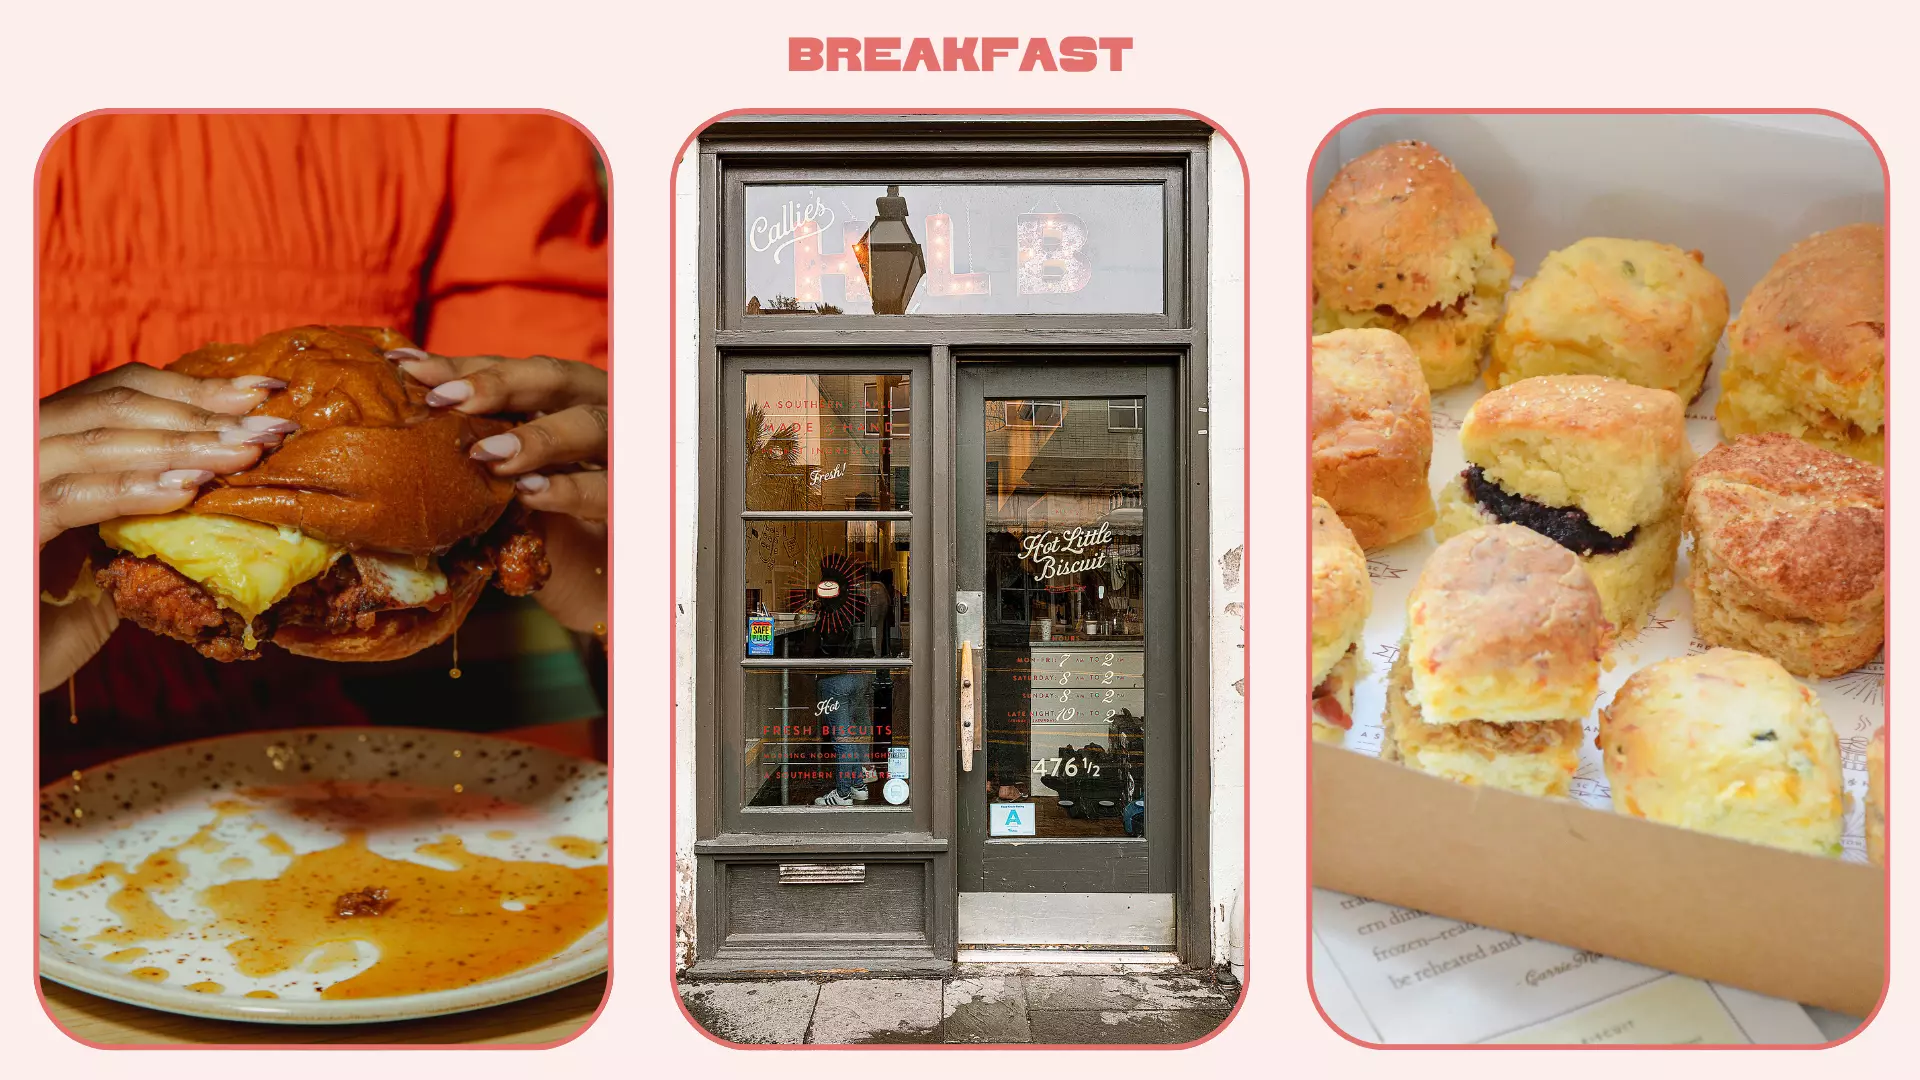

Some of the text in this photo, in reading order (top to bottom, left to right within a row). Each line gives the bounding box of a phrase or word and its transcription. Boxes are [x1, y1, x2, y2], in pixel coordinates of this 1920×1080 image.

[749, 188, 835, 265] Callie's
[777, 400, 843, 409] SOUTHERN
[763, 422, 813, 433] MADE
[809, 462, 847, 486] Fresh!
[1017, 521, 1113, 564] Hot Little
[1034, 551, 1106, 582] Biscuit
[753, 625, 770, 635] SAFE
[753, 634, 770, 642] PLACE
[1059, 653, 1071, 668] 7
[1101, 652, 1115, 667] 2
[1059, 671, 1071, 686] 8
[1101, 670, 1114, 685] 2
[1059, 688, 1071, 703] 8
[1101, 689, 1115, 704] 2
[814, 696, 841, 717] Hot
[1056, 706, 1076, 722] 10
[1102, 709, 1116, 723] 2
[762, 725, 893, 736] FRESH BISCUITS
[775, 771, 833, 779] SOUTHERN
[838, 771, 892, 779] TREASURE
[1032, 757, 1078, 777] 476
[1004, 809, 1022, 825] A
[1414, 944, 1489, 982] reheated
[1489, 932, 1523, 955] and
